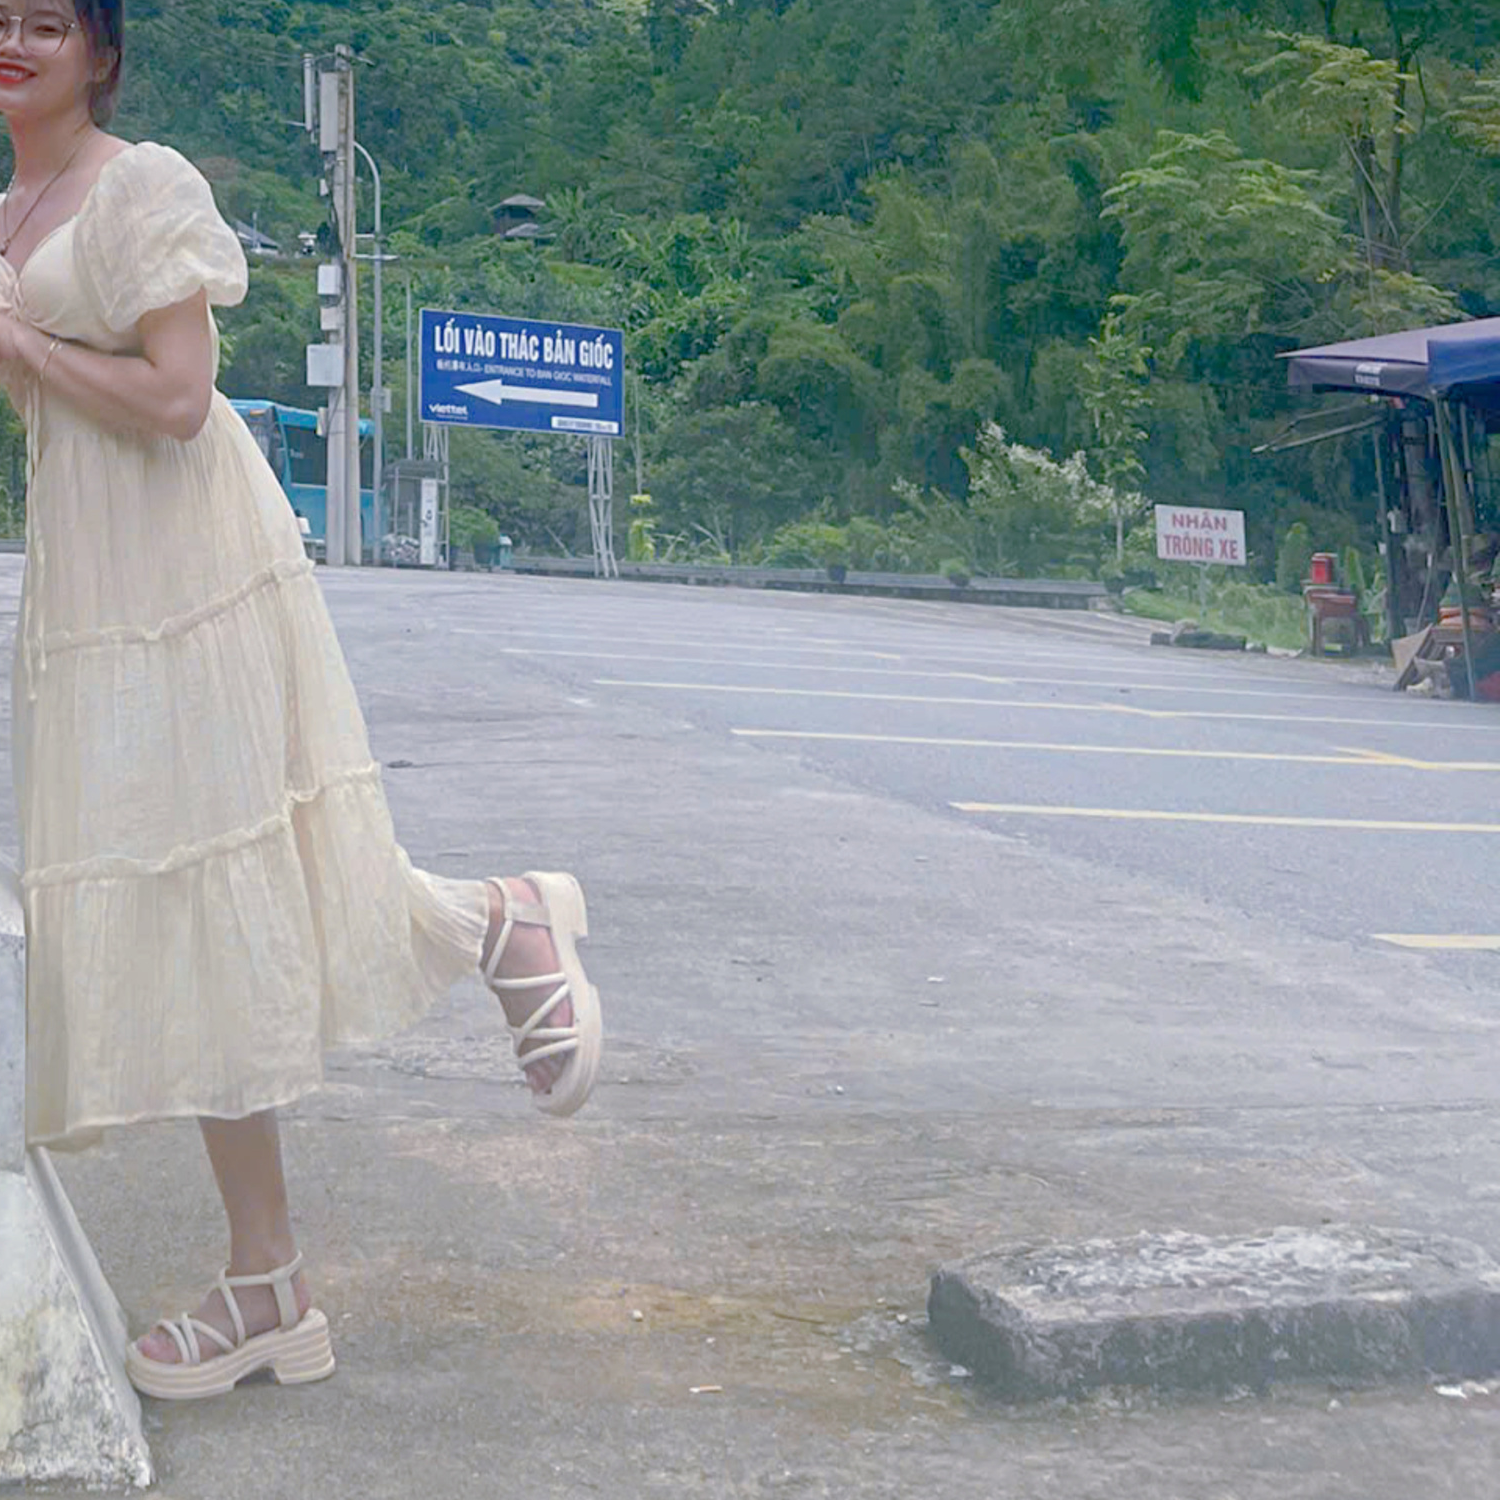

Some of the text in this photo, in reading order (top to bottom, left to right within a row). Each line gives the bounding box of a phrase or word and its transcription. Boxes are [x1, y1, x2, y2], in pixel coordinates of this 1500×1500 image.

[434, 317, 613, 370] LỐI VÀO THÁC BẢN GIỐC
[484, 364, 524, 378] ENTRANCE
[525, 367, 536, 378] TO
[428, 403, 468, 415] viettel
[1218, 539, 1238, 560] XE
